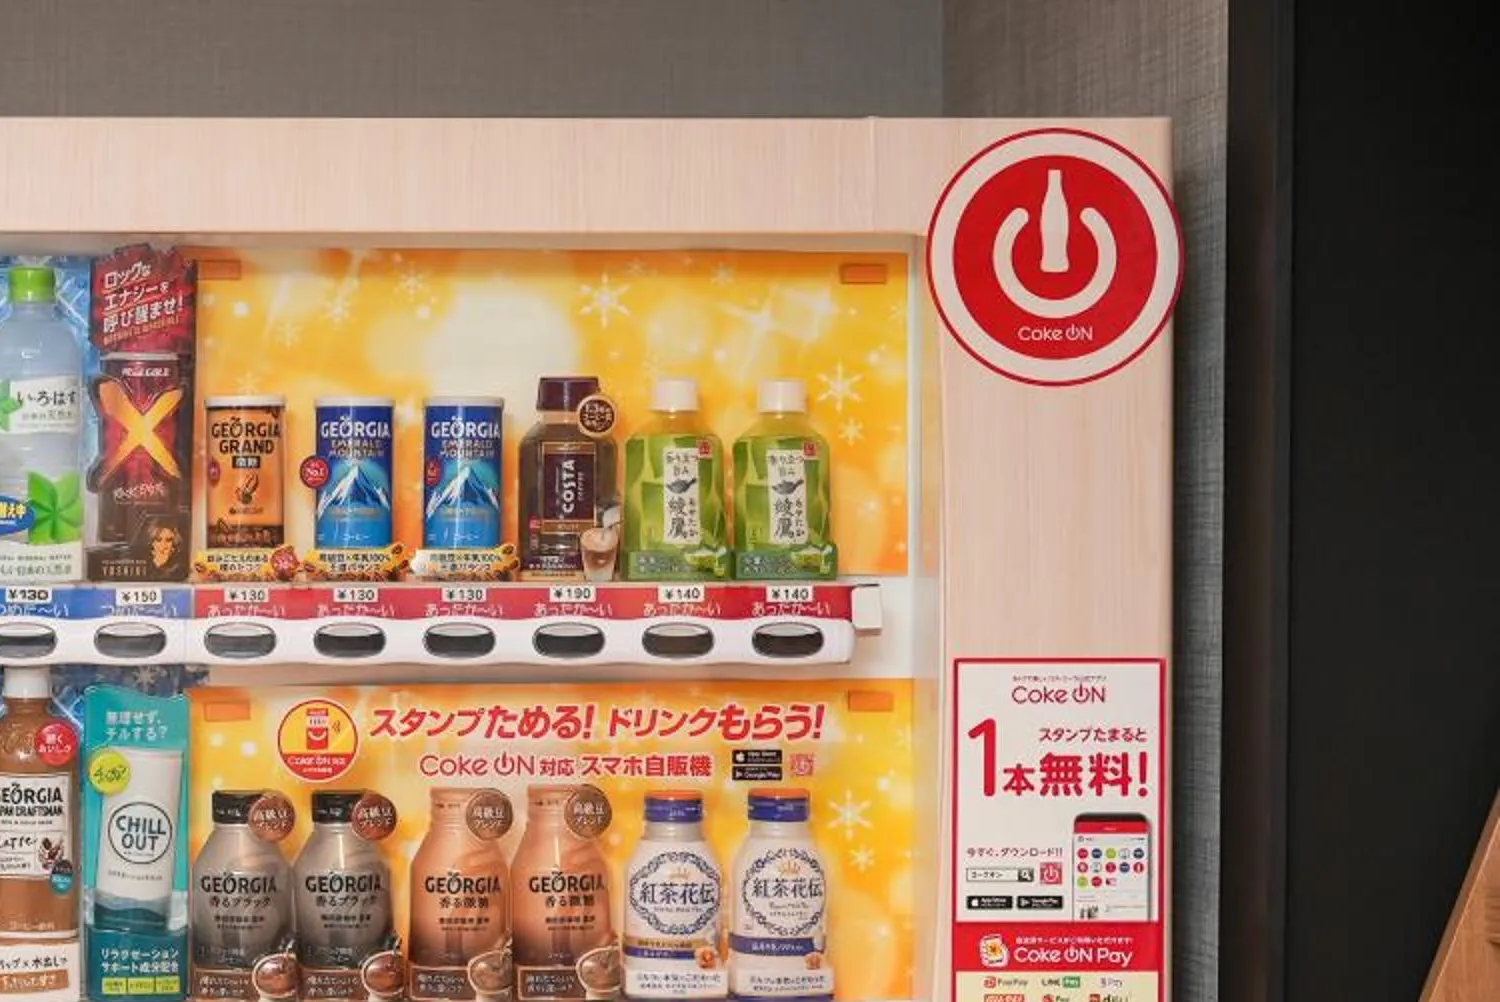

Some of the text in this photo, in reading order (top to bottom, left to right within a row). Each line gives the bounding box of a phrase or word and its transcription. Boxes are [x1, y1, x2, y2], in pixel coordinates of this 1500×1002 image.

[1017, 324, 1093, 341] Coke ON
[17, 390, 77, 407] いろはす
[211, 417, 281, 438] GEORGIA
[321, 416, 391, 438] GEORGIA
[431, 416, 501, 438] GEORGIA
[219, 439, 274, 455] GRAND
[562, 459, 577, 513] COSTA
[8, 589, 49, 601] ¥130
[121, 591, 157, 602] ¥150
[228, 590, 265, 601] ¥130
[337, 589, 375, 600] ¥130
[446, 589, 483, 600] ¥130
[553, 588, 592, 600] ¥190
[663, 588, 701, 600] ¥140
[771, 588, 809, 600] ¥140
[1011, 683, 1106, 704] Coke ON
[369, 703, 823, 740] スタンプためる! ドリンクもらう!
[1039, 727, 1148, 743] スタンプたまると
[419, 752, 712, 777] Coke ON 対応 スマホ自販機
[968, 718, 1148, 797] 1本無料!
[115, 815, 167, 835] CHILL
[121, 834, 159, 851] OUT
[200, 872, 277, 894] GEORGIA
[305, 872, 382, 894] GEORGIA
[425, 873, 501, 894] GEORGIA
[529, 873, 605, 894] GEORGIA
[752, 879, 823, 898] 紅茶花伝
[639, 882, 715, 906] 紅茶花伝
[1013, 947, 1133, 967] Coke ON Pay
